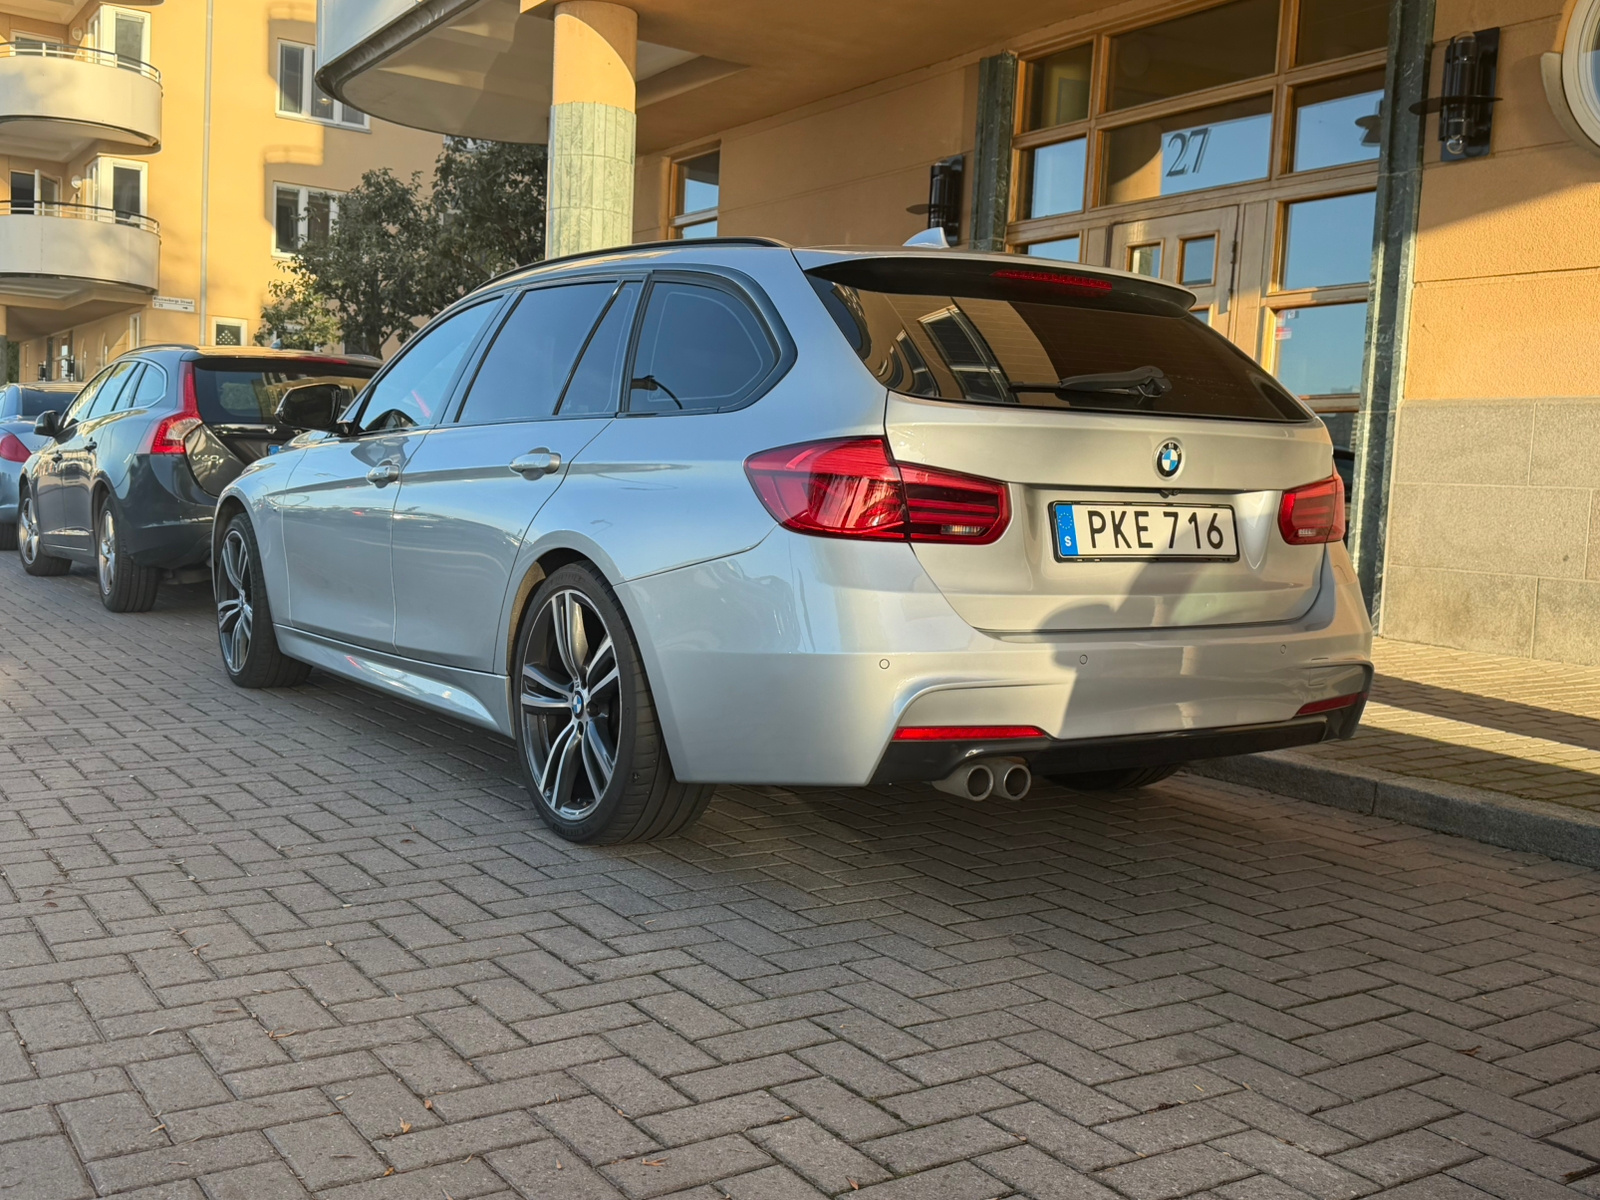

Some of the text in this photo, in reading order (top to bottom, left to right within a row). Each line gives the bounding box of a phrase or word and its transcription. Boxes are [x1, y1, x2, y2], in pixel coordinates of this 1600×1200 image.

[1166, 127, 1209, 178] 27
[1064, 535, 1072, 547] S
[1087, 510, 1224, 550] PKE 716
